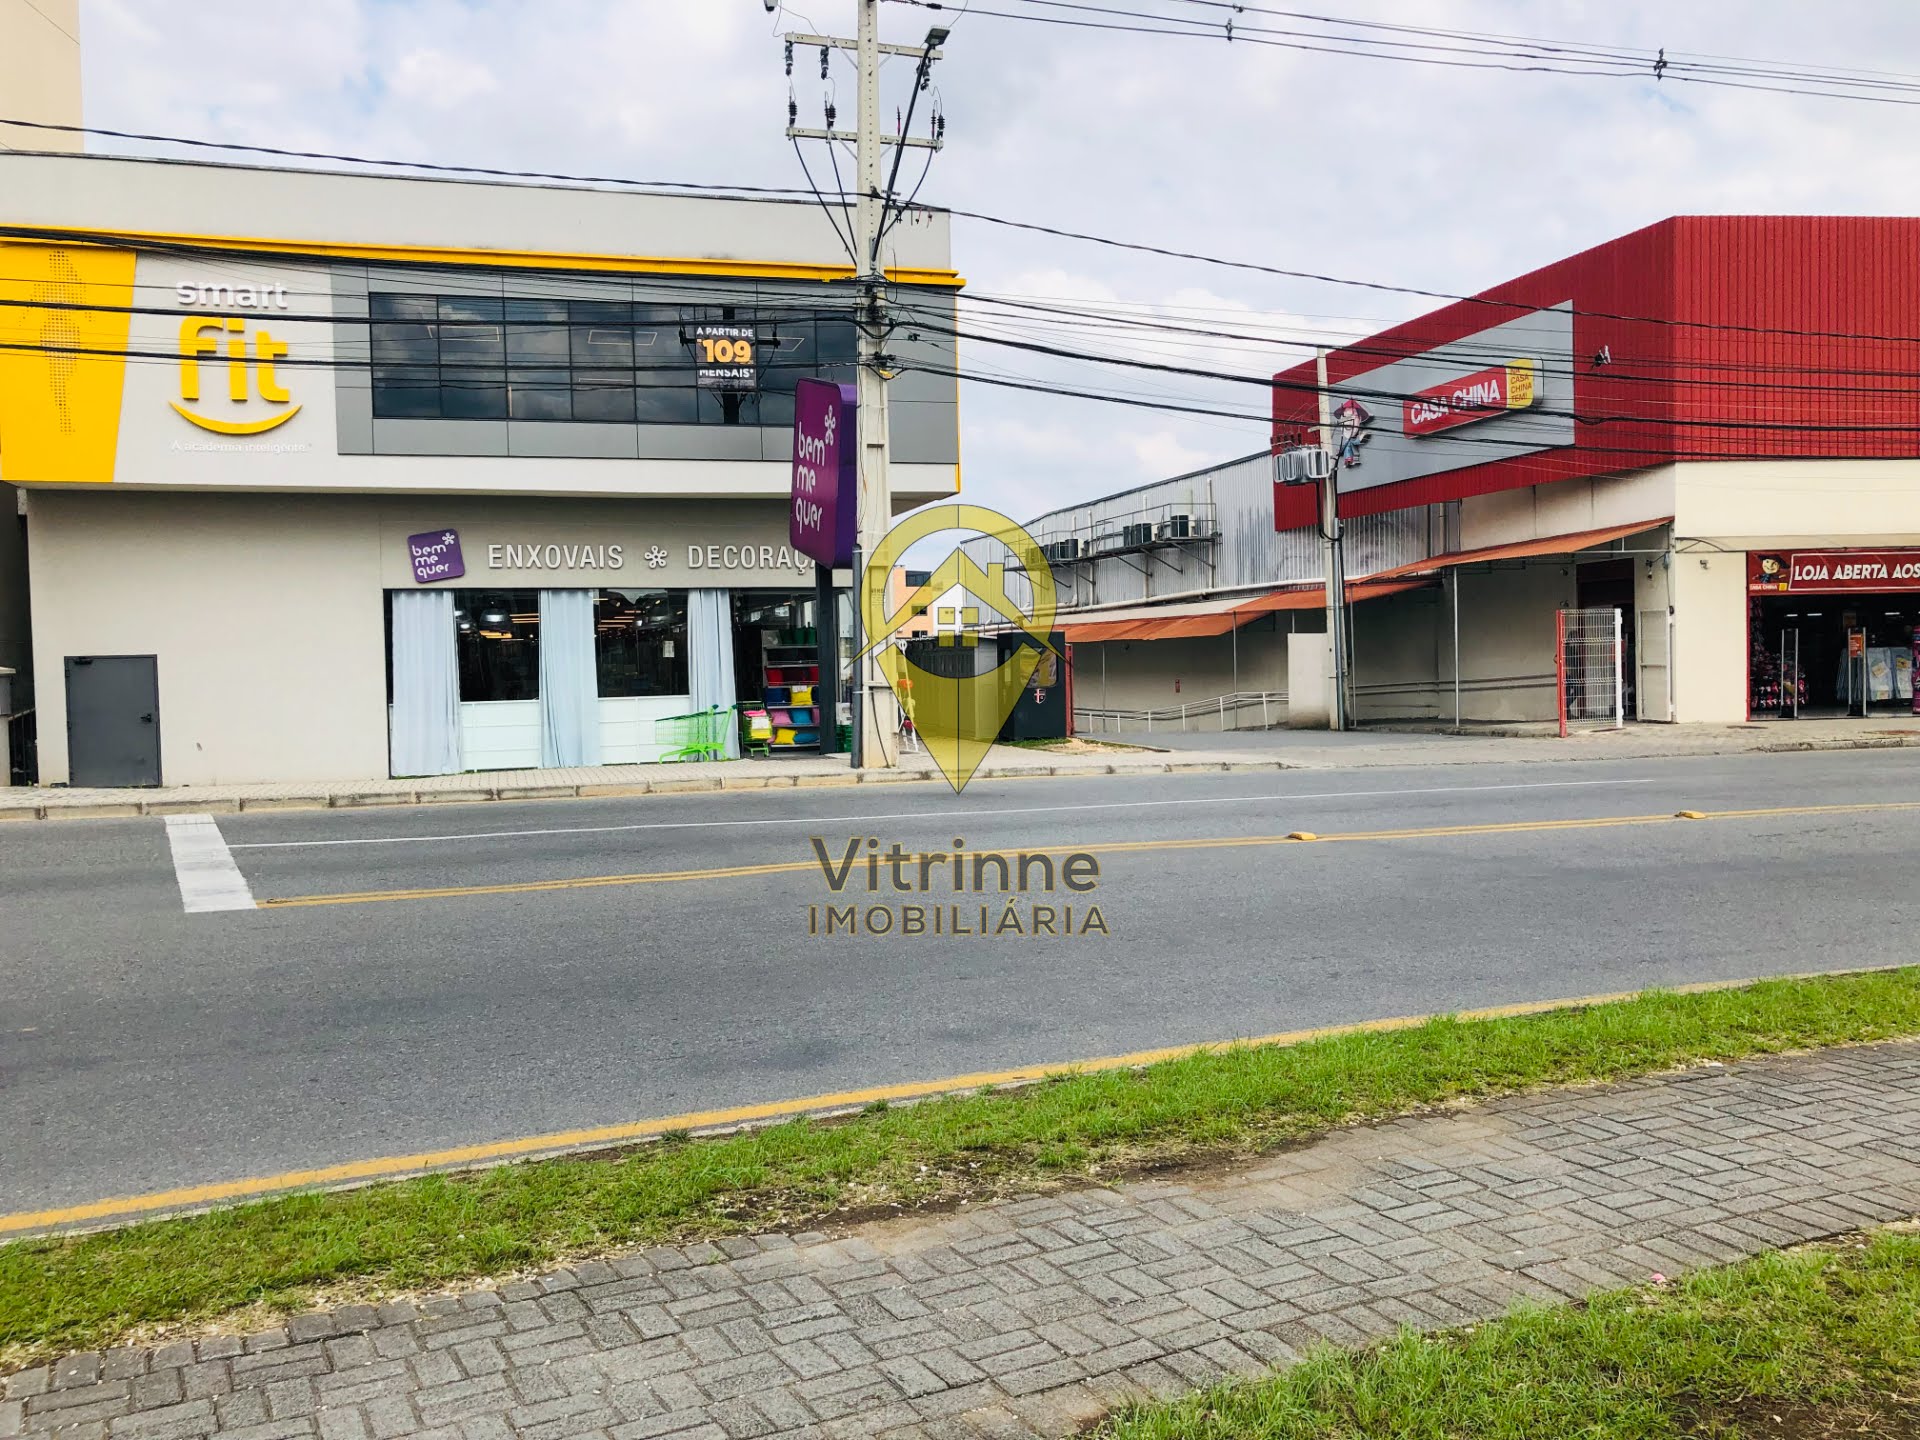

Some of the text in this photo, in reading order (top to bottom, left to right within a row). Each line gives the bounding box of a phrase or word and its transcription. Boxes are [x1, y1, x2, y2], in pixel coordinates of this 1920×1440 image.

[177, 281, 287, 309] smart
[697, 327, 753, 337] A PARTIR DE
[179, 315, 289, 401] fit
[703, 339, 751, 363] 109
[1511, 374, 1530, 384] CASA
[1511, 383, 1532, 393] CHINA
[1411, 379, 1500, 424] CASA CHINA
[798, 421, 825, 467] bem
[797, 464, 816, 494] me
[796, 497, 823, 534] quer
[412, 544, 447, 556] bem
[415, 555, 439, 566] me
[488, 545, 815, 575] ENXOVAIS DECORAÇ
[417, 563, 449, 579] quer
[1795, 565, 1829, 580] LOJA
[1833, 564, 1888, 580] ABERTA
